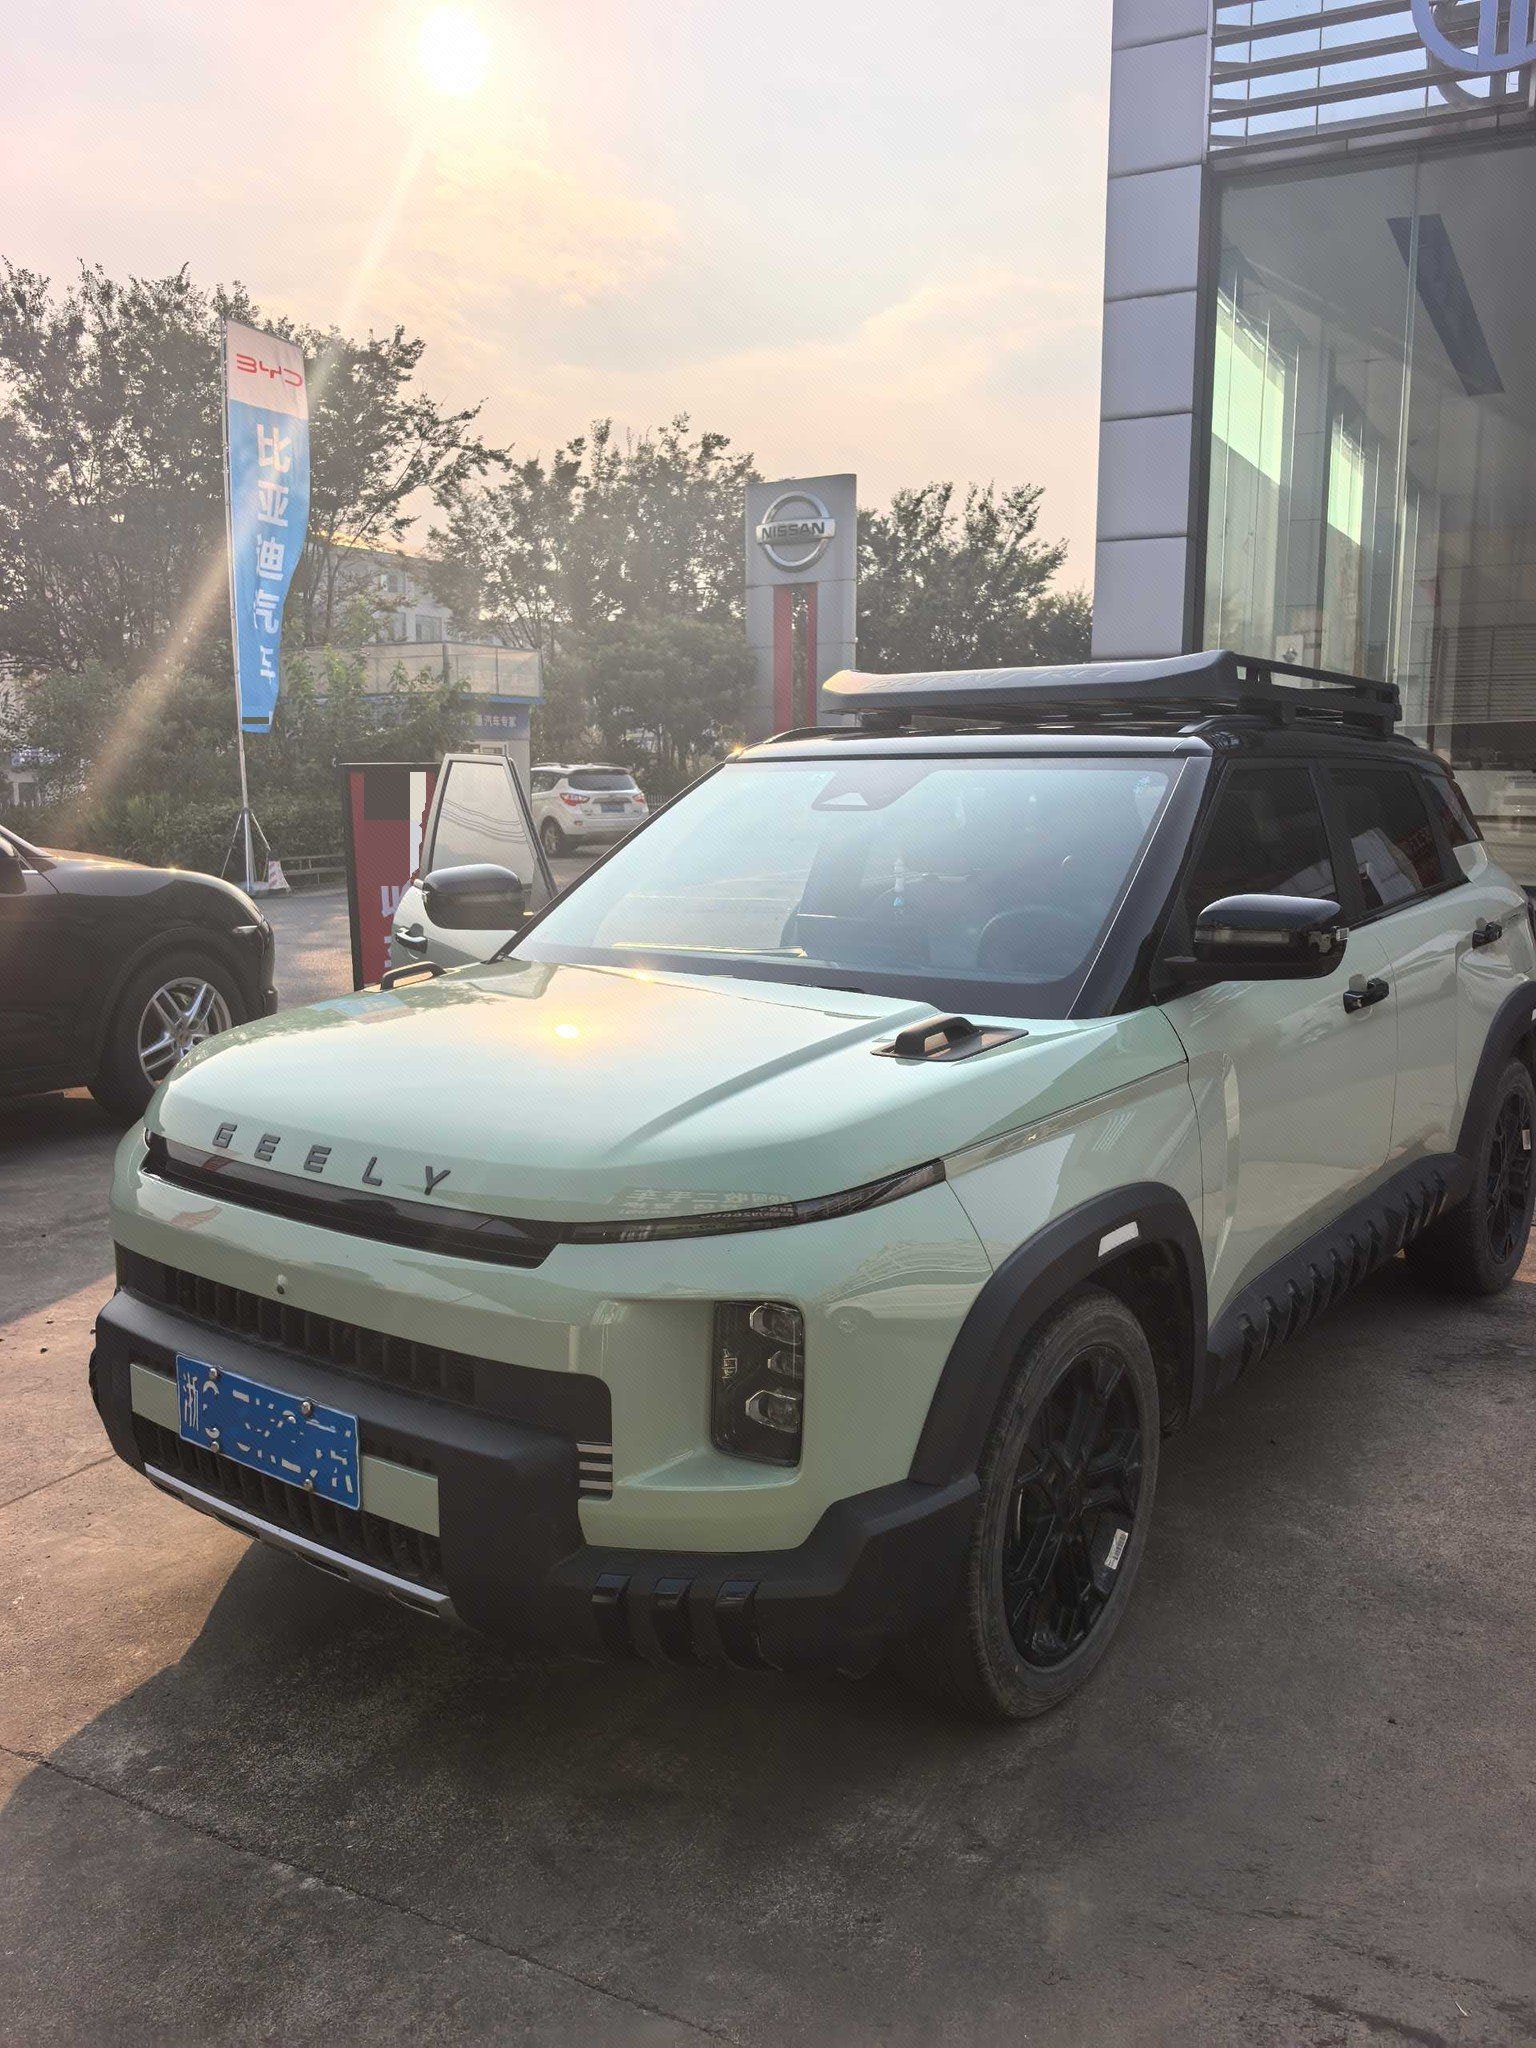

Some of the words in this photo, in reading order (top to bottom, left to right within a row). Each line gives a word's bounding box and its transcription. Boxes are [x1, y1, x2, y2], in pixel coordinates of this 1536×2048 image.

[236, 353, 303, 387] BYD
[762, 521, 825, 541] NISSAN
[211, 1121, 451, 1196] GEELY
